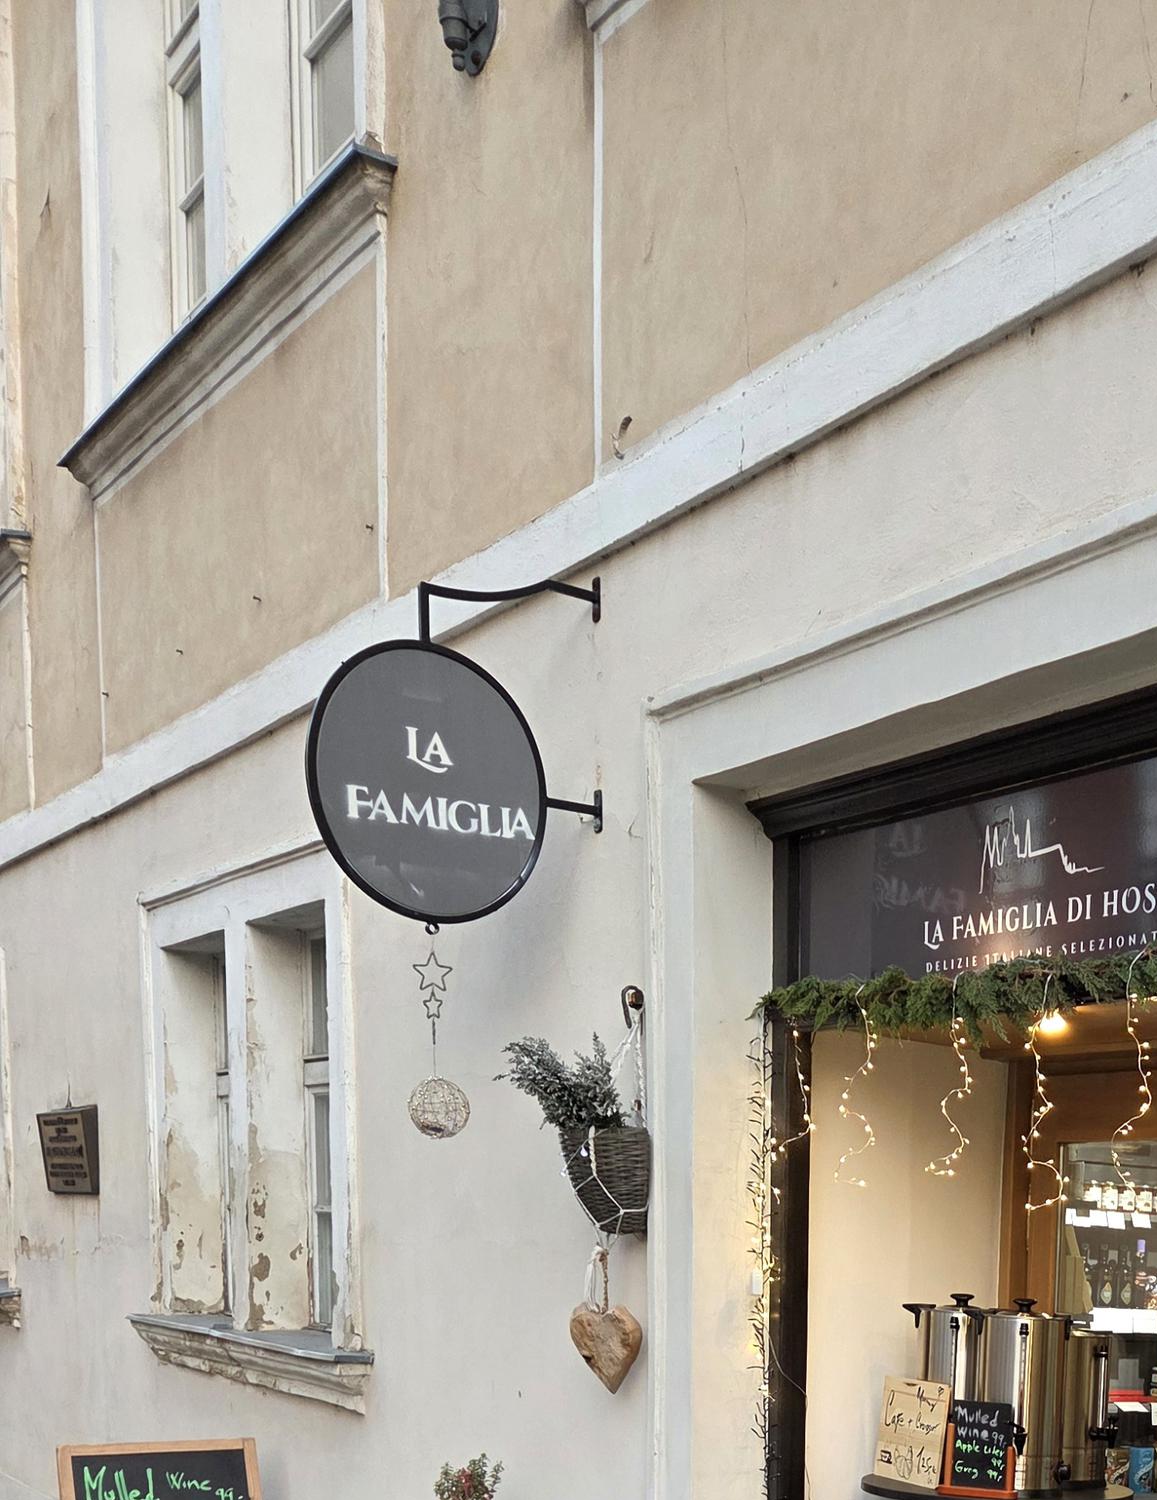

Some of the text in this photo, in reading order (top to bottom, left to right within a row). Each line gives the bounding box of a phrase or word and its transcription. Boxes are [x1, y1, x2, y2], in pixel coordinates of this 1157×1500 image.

[405, 726, 454, 773] LA
[345, 784, 535, 841] FAMIGLIA
[923, 920, 944, 950] LA
[951, 901, 1058, 941] FAMIGLIA
[1067, 894, 1092, 924] DI
[926, 956, 978, 974] DELIZIE
[957, 1405, 999, 1427] Mulled
[957, 1426, 989, 1440] Wine
[956, 1439, 980, 1453] Apple
[166, 1471, 212, 1491] Wine
